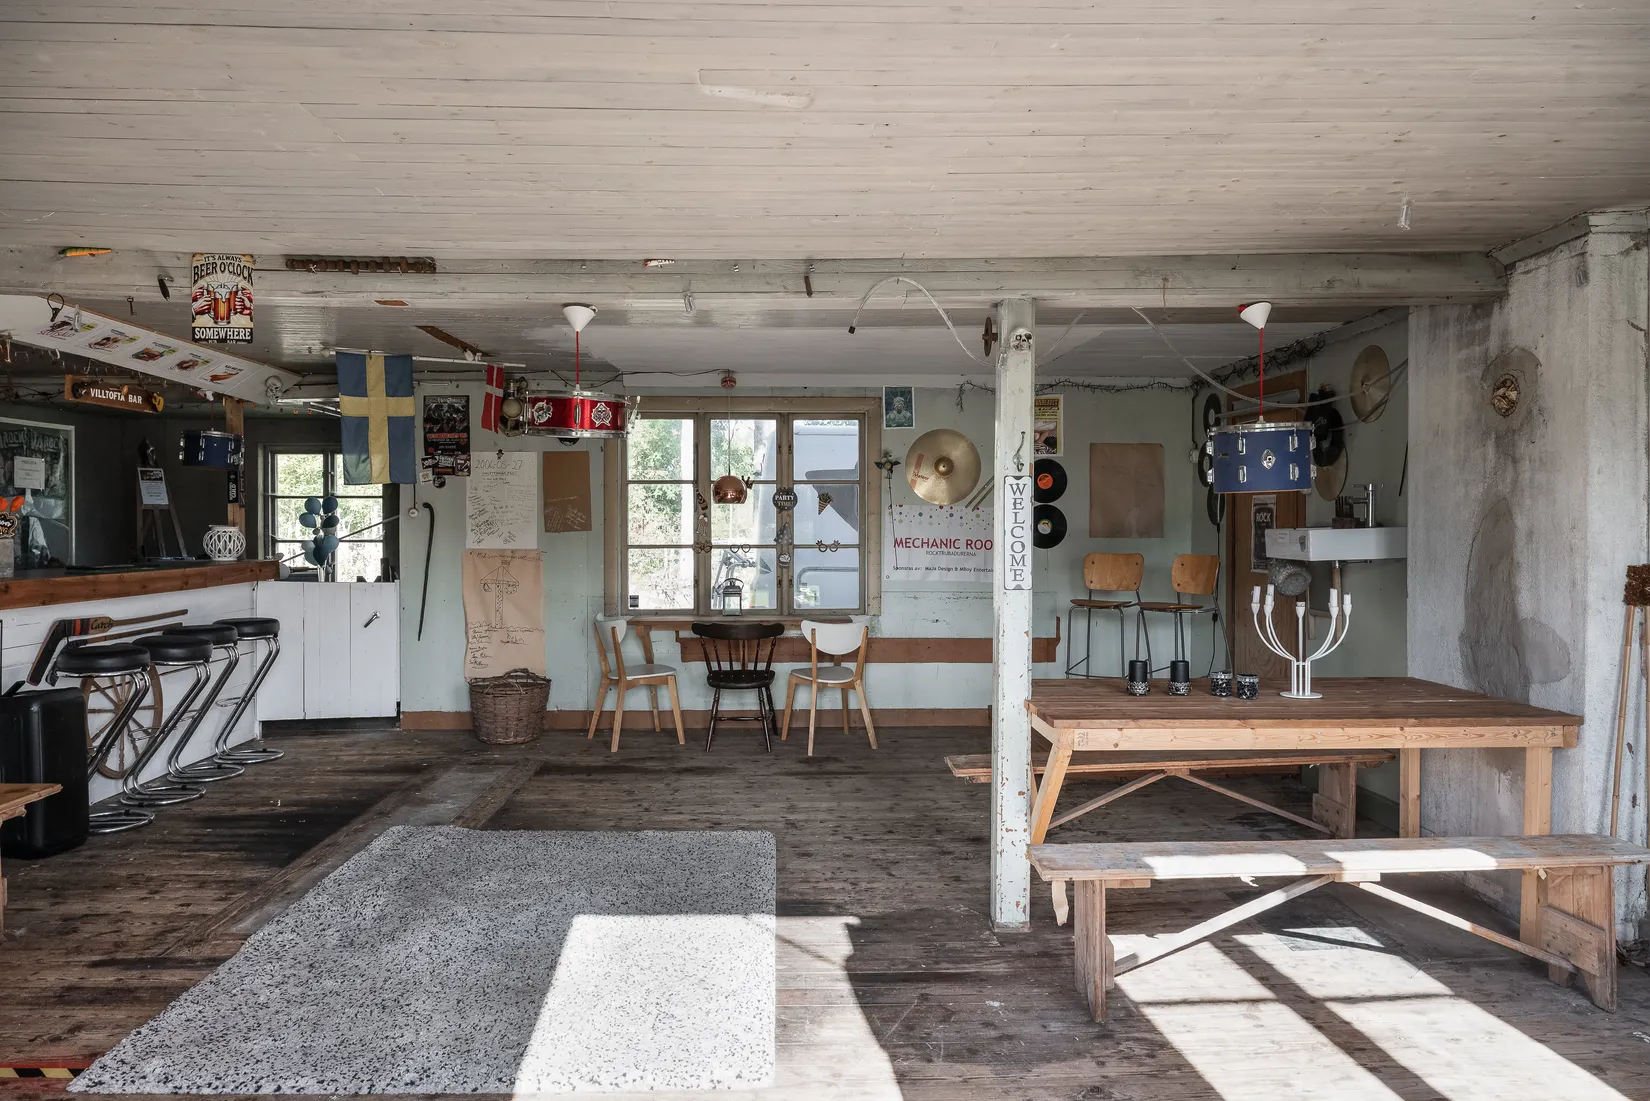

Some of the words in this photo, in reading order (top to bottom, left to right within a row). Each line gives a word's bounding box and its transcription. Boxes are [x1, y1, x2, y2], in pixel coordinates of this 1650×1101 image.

[204, 255, 216, 263] IT'S
[217, 254, 242, 263] ALWAYS
[193, 262, 218, 287] BEER
[219, 262, 254, 287] O'CLOCK
[194, 328, 251, 340] SOMEWHERE
[90, 387, 125, 402] VILLTOFTA
[128, 394, 142, 404] BAR
[1008, 483, 1028, 582] WELCOME
[893, 537, 961, 549] MECHANIC
[965, 539, 994, 551] ROO
[91, 618, 114, 630] Catch
